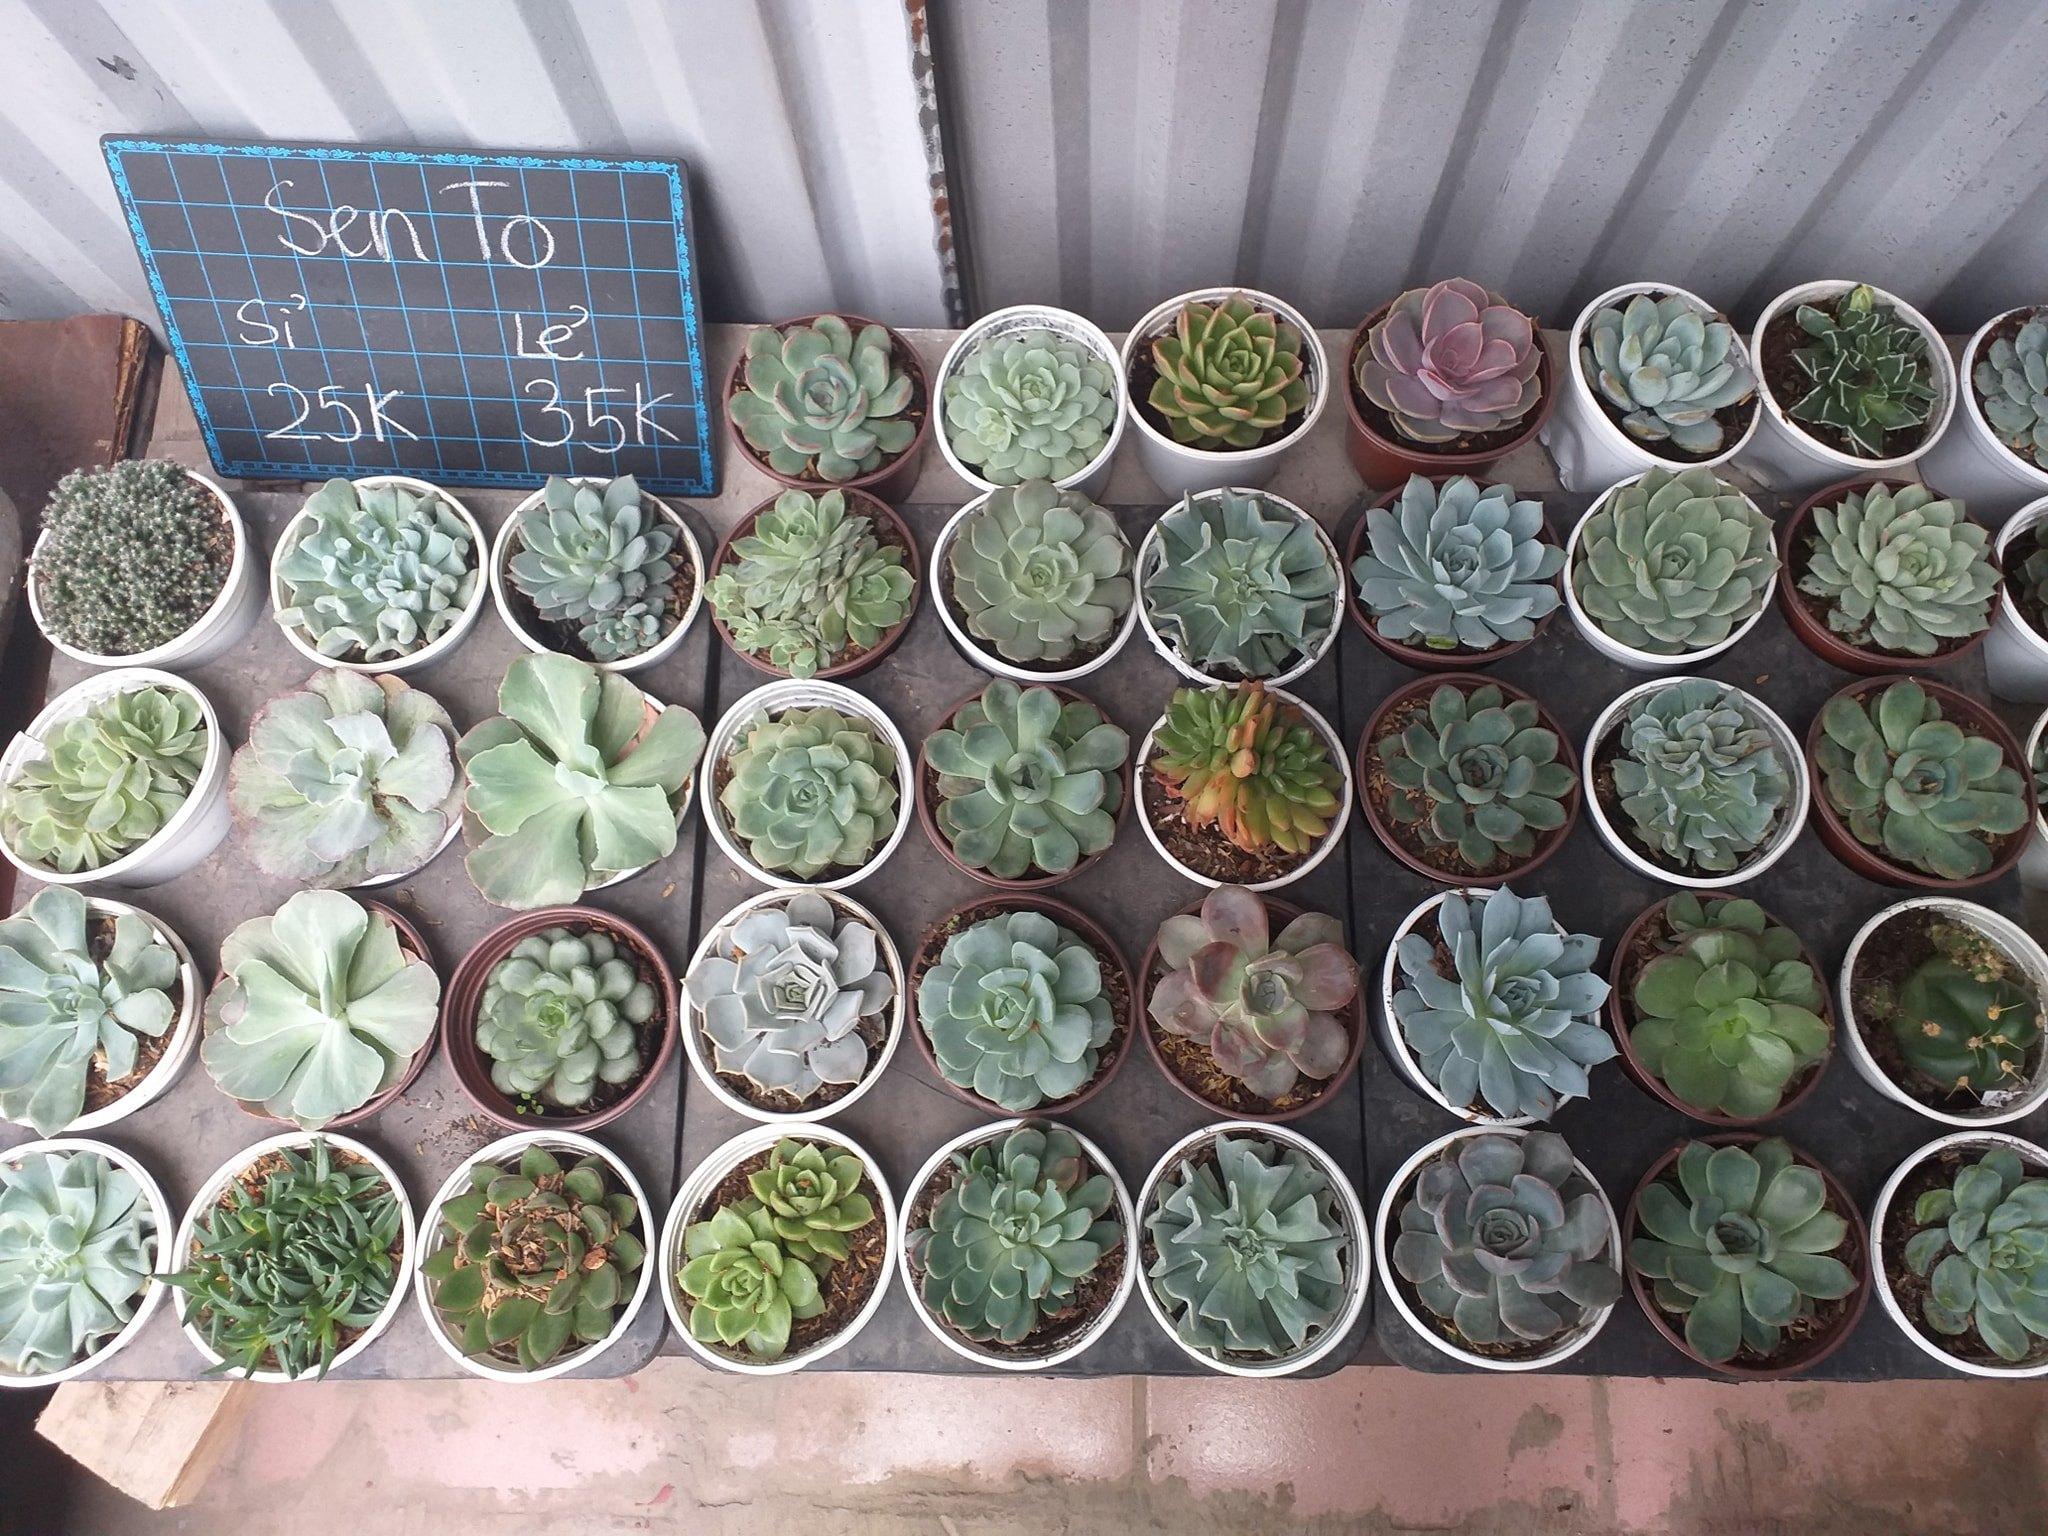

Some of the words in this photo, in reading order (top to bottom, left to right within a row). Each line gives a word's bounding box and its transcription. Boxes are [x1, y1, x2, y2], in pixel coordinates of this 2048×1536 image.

[264, 180, 430, 262] Sen
[440, 181, 555, 269] To
[265, 382, 419, 442] 25K
